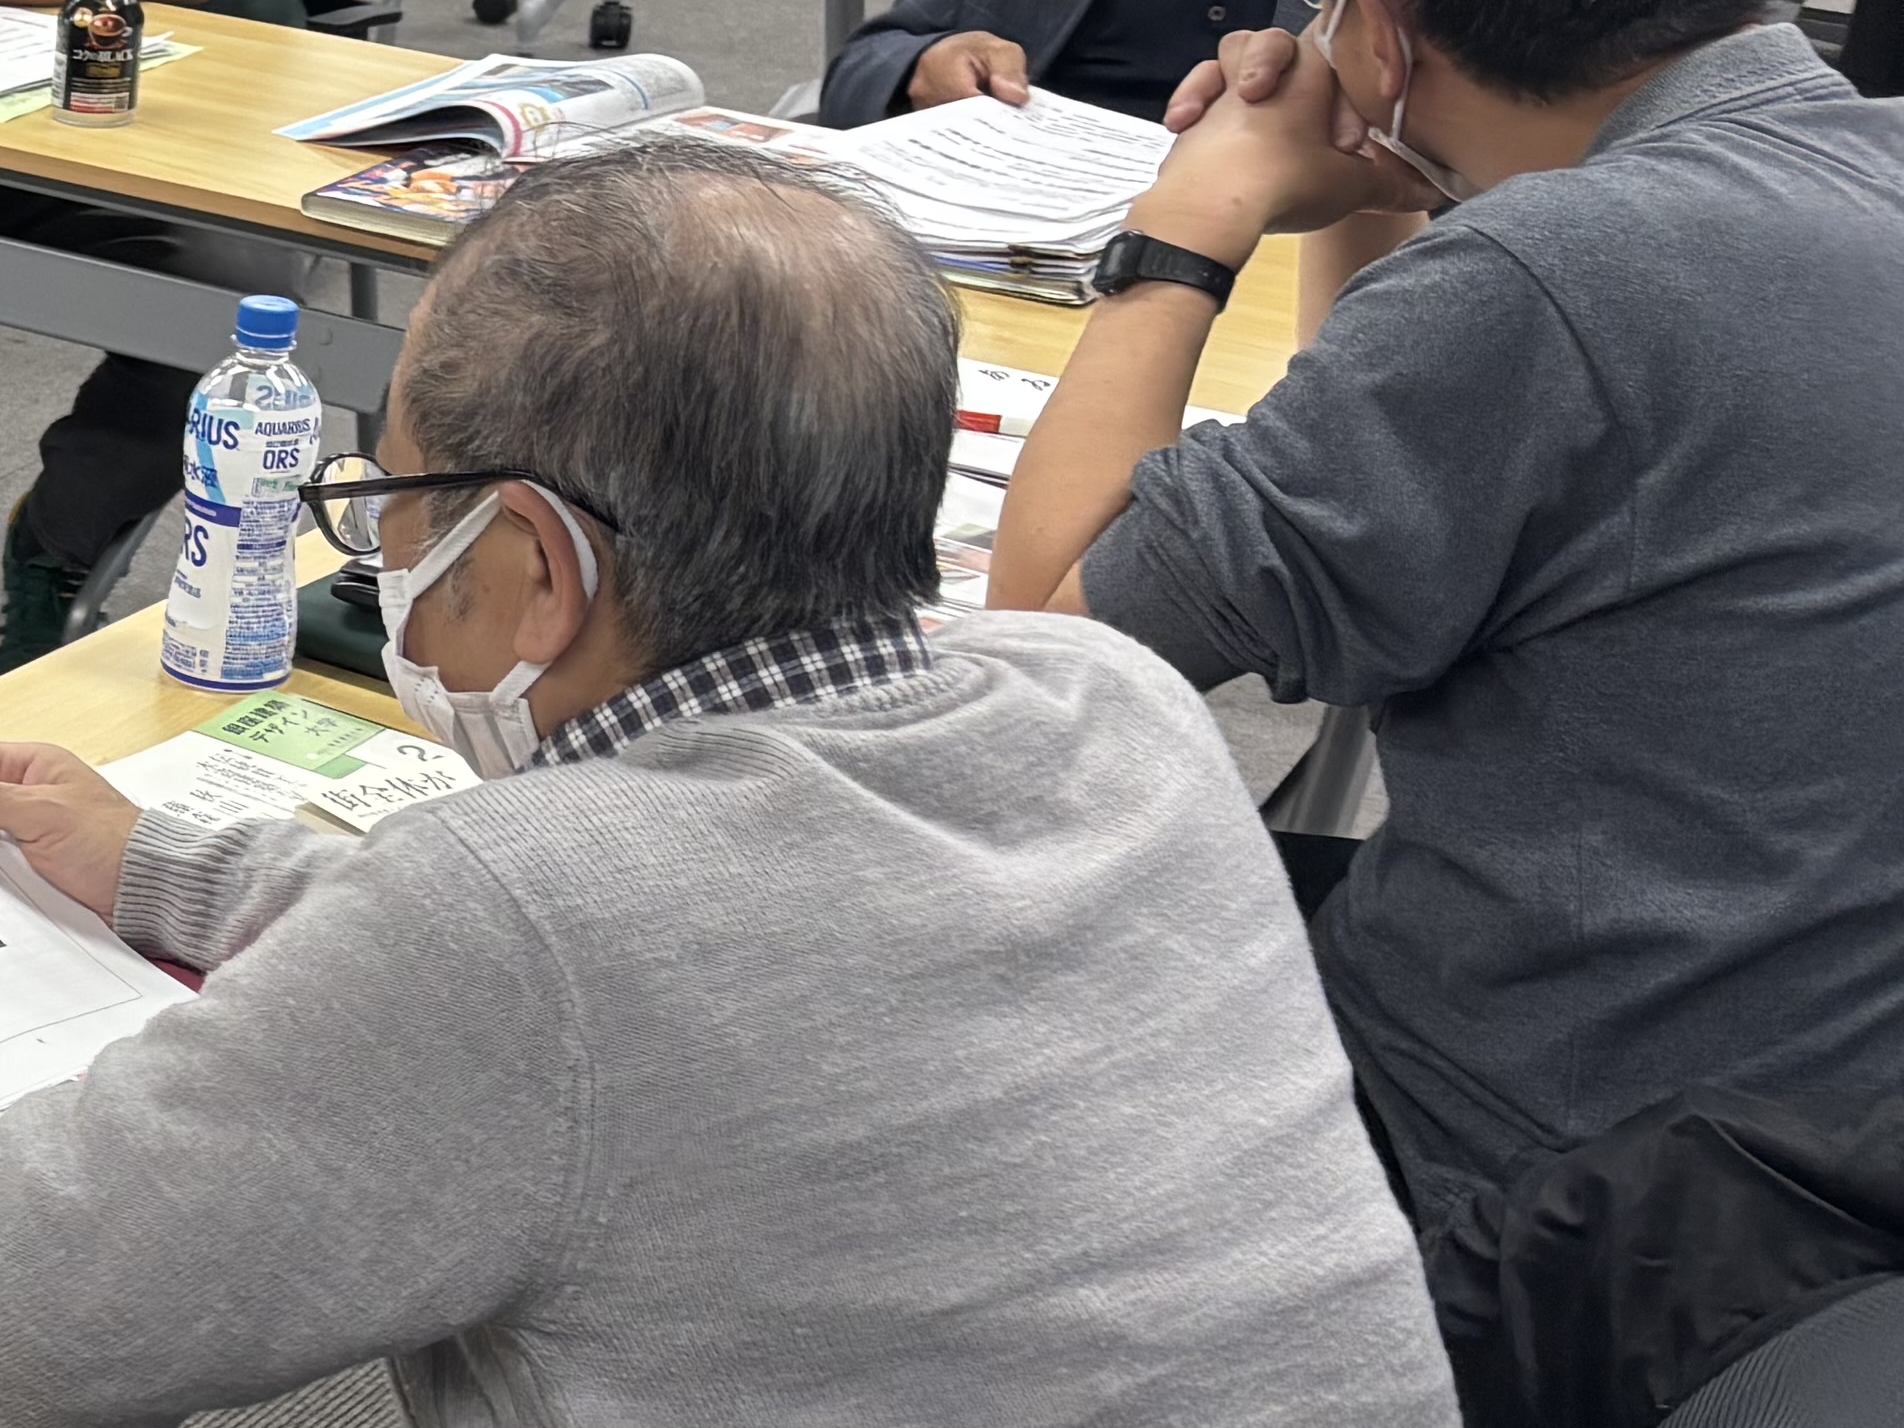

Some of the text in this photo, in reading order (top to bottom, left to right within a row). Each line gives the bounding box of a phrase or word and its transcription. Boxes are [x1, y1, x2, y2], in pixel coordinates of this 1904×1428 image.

[255, 419, 311, 437] AQUARIUS
[263, 448, 300, 471] ORS
[249, 709, 308, 743] デザイン
